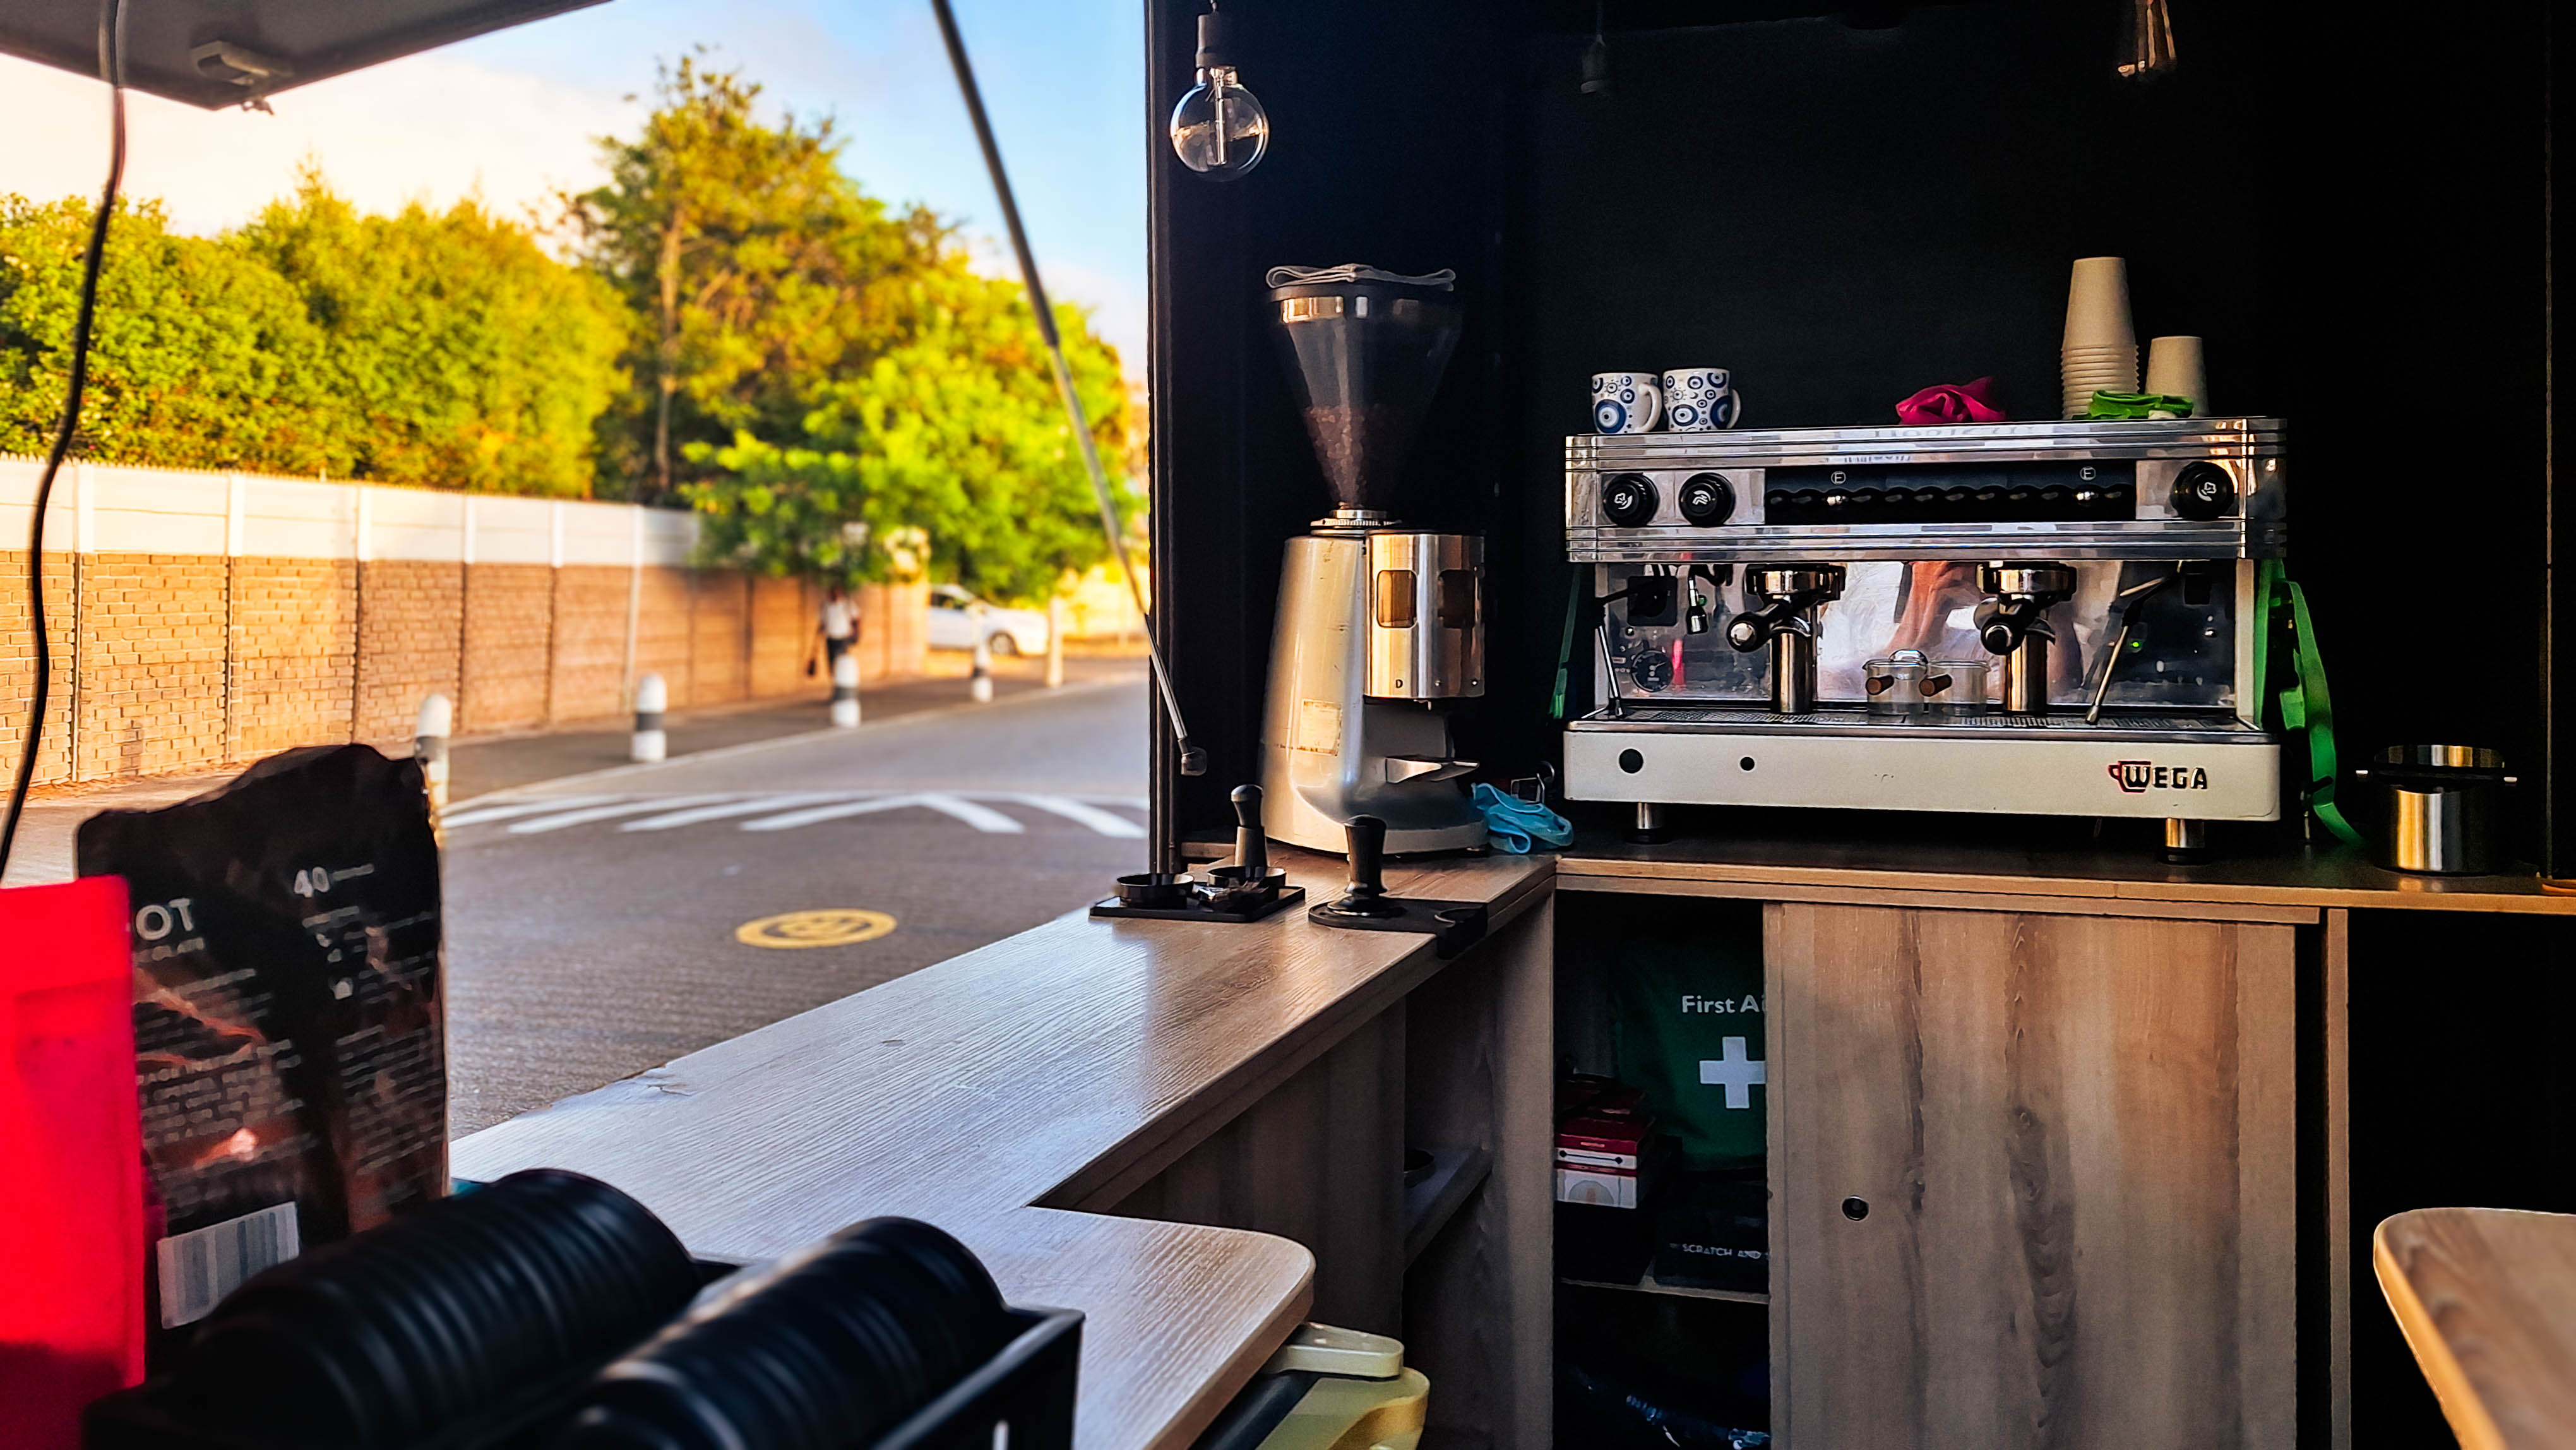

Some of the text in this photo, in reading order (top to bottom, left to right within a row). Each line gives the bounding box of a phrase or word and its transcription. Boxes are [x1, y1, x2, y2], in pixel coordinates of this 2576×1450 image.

[2121, 763, 2208, 789] WEGA
[294, 866, 330, 899] 40
[1681, 995, 1736, 1014] First
[1681, 1243, 1733, 1256] SCRATCH
